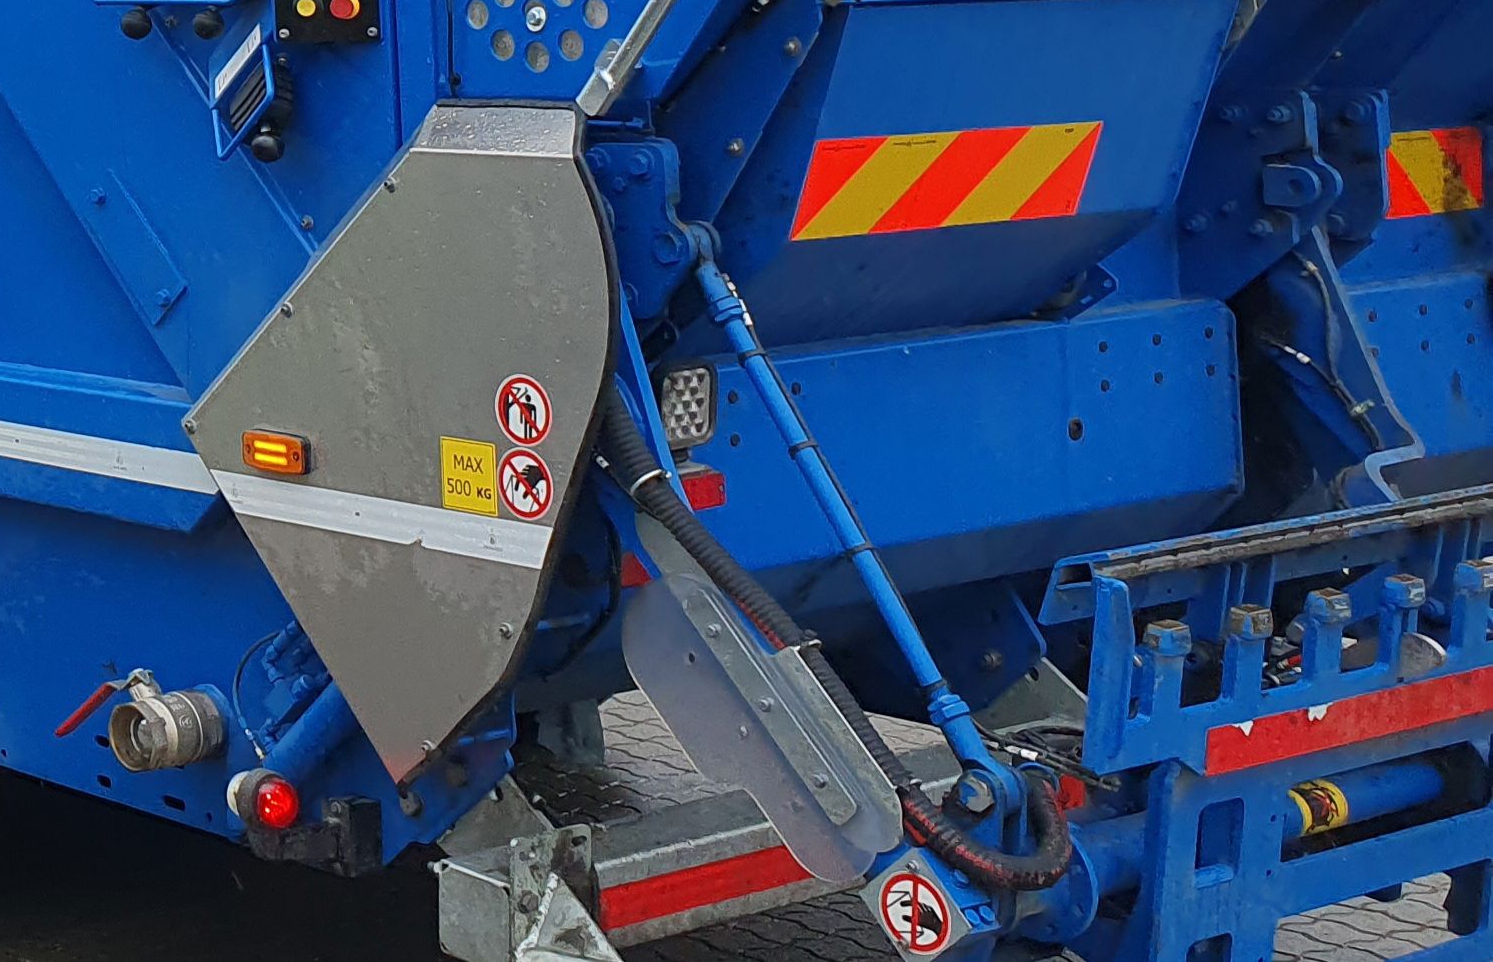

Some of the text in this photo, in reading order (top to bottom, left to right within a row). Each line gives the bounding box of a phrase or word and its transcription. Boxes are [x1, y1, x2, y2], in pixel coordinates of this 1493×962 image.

[453, 454, 484, 474] MAX
[447, 477, 492, 500] 500 KG
